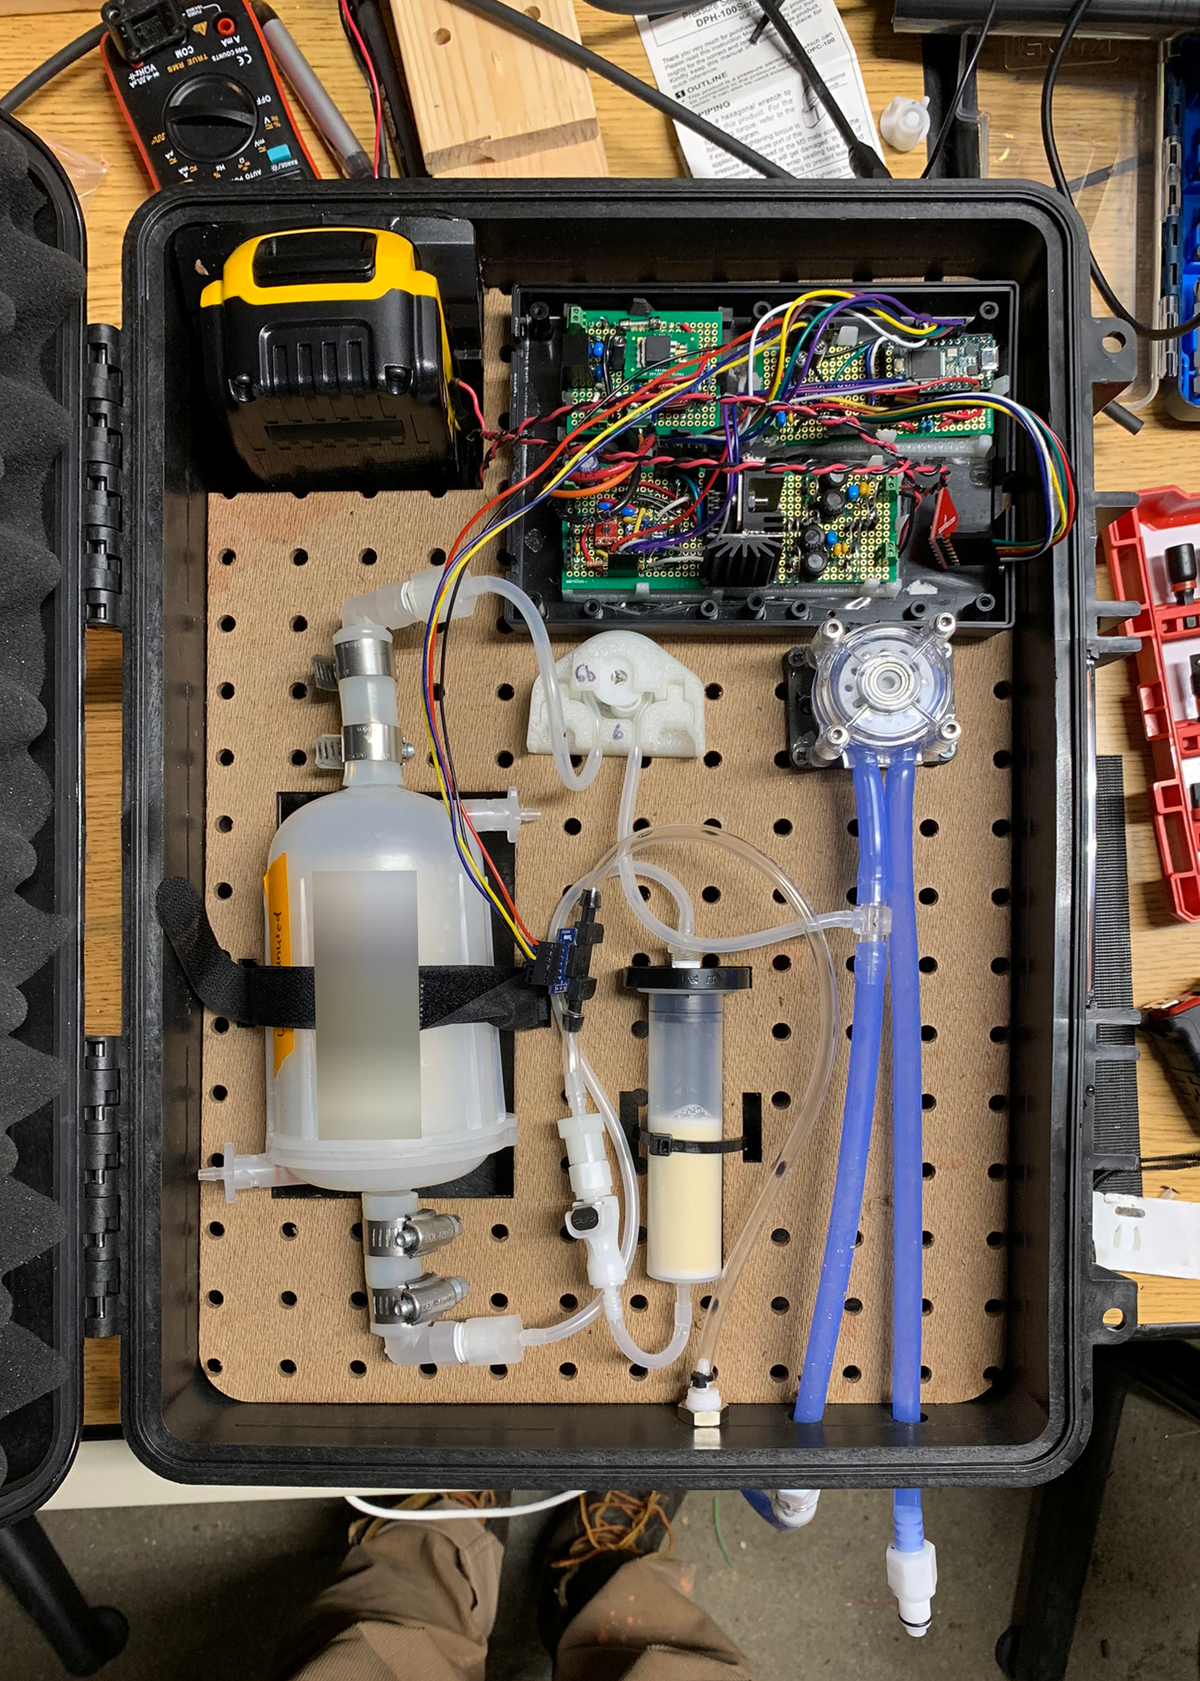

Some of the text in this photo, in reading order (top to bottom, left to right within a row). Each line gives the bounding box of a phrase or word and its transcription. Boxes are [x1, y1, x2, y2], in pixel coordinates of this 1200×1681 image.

[682, 2, 718, 20] Pressure
[175, 45, 194, 59] COM
[662, 53, 679, 63] Thank
[680, 49, 690, 57] you
[690, 44, 703, 52] very
[703, 37, 719, 46] much
[664, 58, 684, 70] Please
[685, 52, 698, 61] read
[699, 47, 710, 55] this
[710, 33, 742, 50] Instruction
[726, 42, 739, 50] and
[805, 37, 836, 54] DPC-100
[166, 53, 209, 73] TRUE RMS
[668, 71, 689, 84] Kindly
[689, 64, 706, 75] keep
[706, 58, 718, 66] this
[719, 47, 743, 60] manual
[685, 71, 729, 92] OUTLINE
[256, 94, 271, 105] OFF
[720, 103, 756, 121] hexagonal
[757, 92, 781, 106] wrench
[767, 102, 780, 111] For
[758, 113, 775, 124] refer
[245, 168, 262, 180] AUTO
